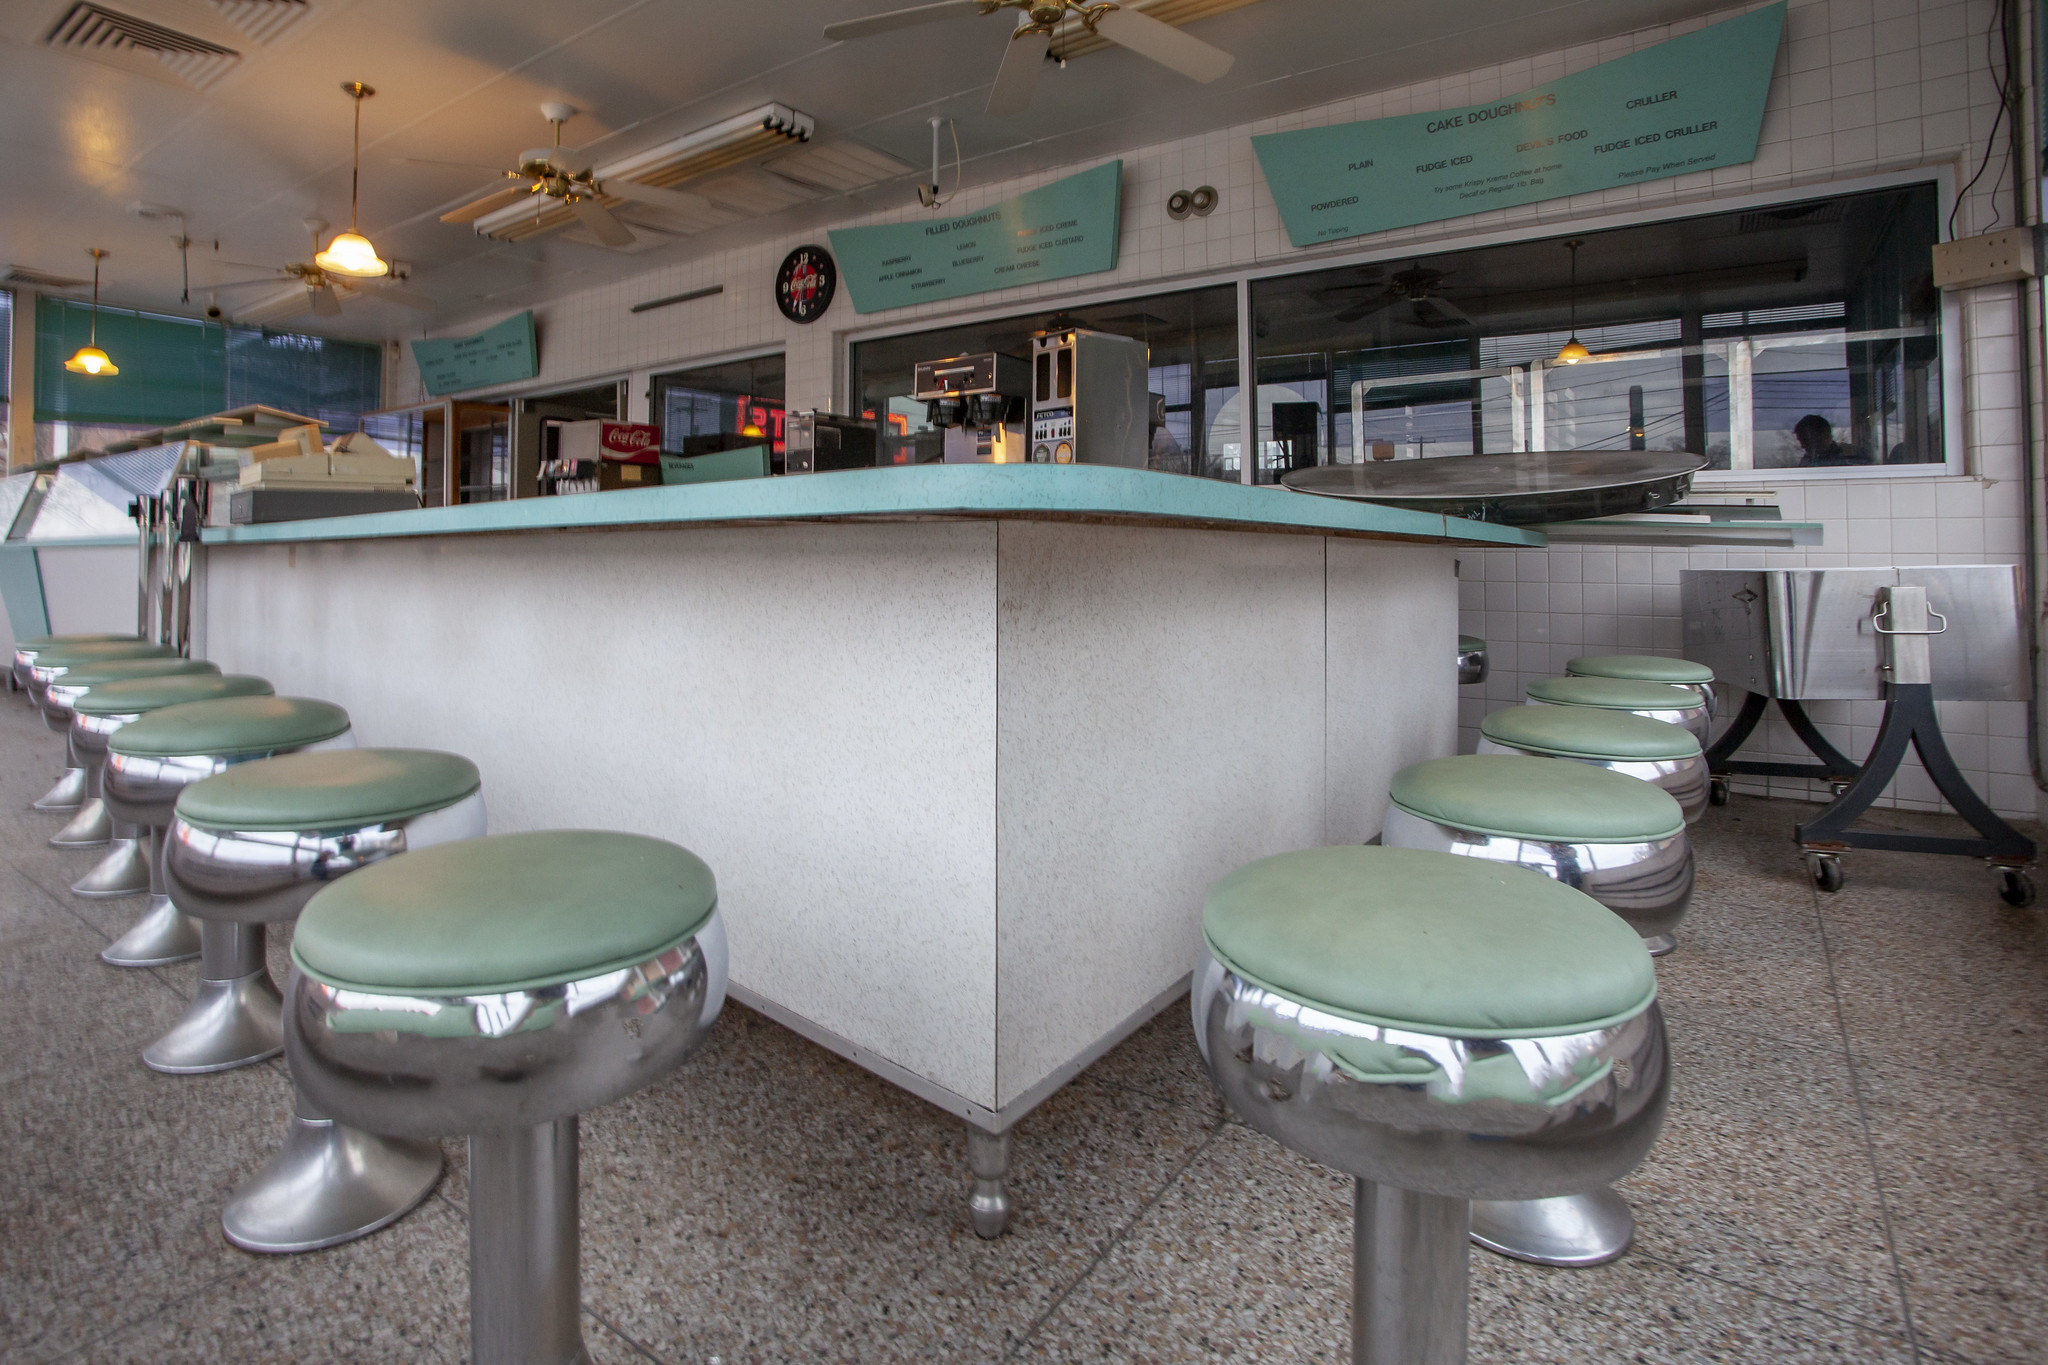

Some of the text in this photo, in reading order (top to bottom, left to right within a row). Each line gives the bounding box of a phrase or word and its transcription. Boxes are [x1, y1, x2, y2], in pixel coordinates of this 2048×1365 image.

[1626, 90, 1678, 110] CRULLER
[1426, 93, 1557, 134] CAKE DOUGHNUTS
[1516, 129, 1589, 153] DEVILS FOOD
[1593, 120, 1718, 154] FUDGE ICED CRULLER
[1348, 159, 1374, 171] PLAIN
[1416, 155, 1473, 174] FUDGE ICED
[1618, 153, 1716, 179] Please Pay When Served
[1434, 186, 1443, 194] Try
[1510, 169, 1532, 179] Coffee
[1530, 177, 1544, 187] Bag
[1311, 196, 1359, 212] POWDERED
[925, 210, 1002, 236] FILLED DOUGHNUTS
[957, 241, 977, 251] LEMON
[1039, 241, 1053, 250] ICED
[1055, 235, 1084, 246] CUSTARD
[800, 252, 809, 265] 12
[994, 260, 1040, 274] CREAM CHEESE
[783, 281, 789, 294] 9
[819, 274, 826, 286] 3
[911, 278, 946, 290] STRAWBERRY
[800, 304, 807, 317] 6
[608, 427, 651, 448] Coca-Cola
